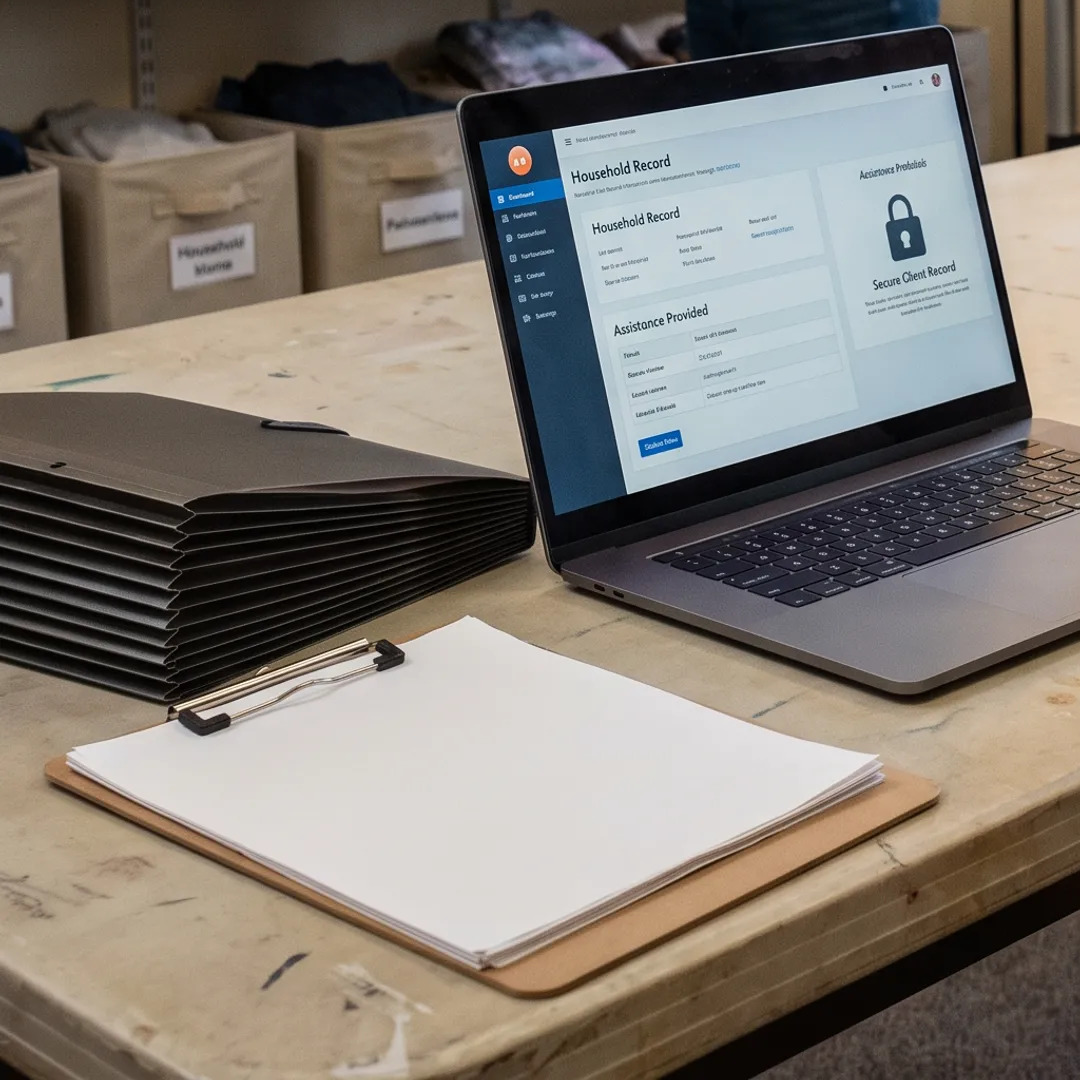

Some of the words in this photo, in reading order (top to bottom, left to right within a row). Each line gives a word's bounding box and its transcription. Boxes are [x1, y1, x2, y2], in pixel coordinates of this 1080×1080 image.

[571, 161, 631, 185] Household
[633, 153, 671, 172] Record
[592, 214, 645, 235] Household
[647, 206, 681, 224] Record
[873, 277, 901, 291] Secure
[927, 260, 956, 277] Record
[613, 314, 665, 337] Assistance
[666, 304, 709, 324] Provided
